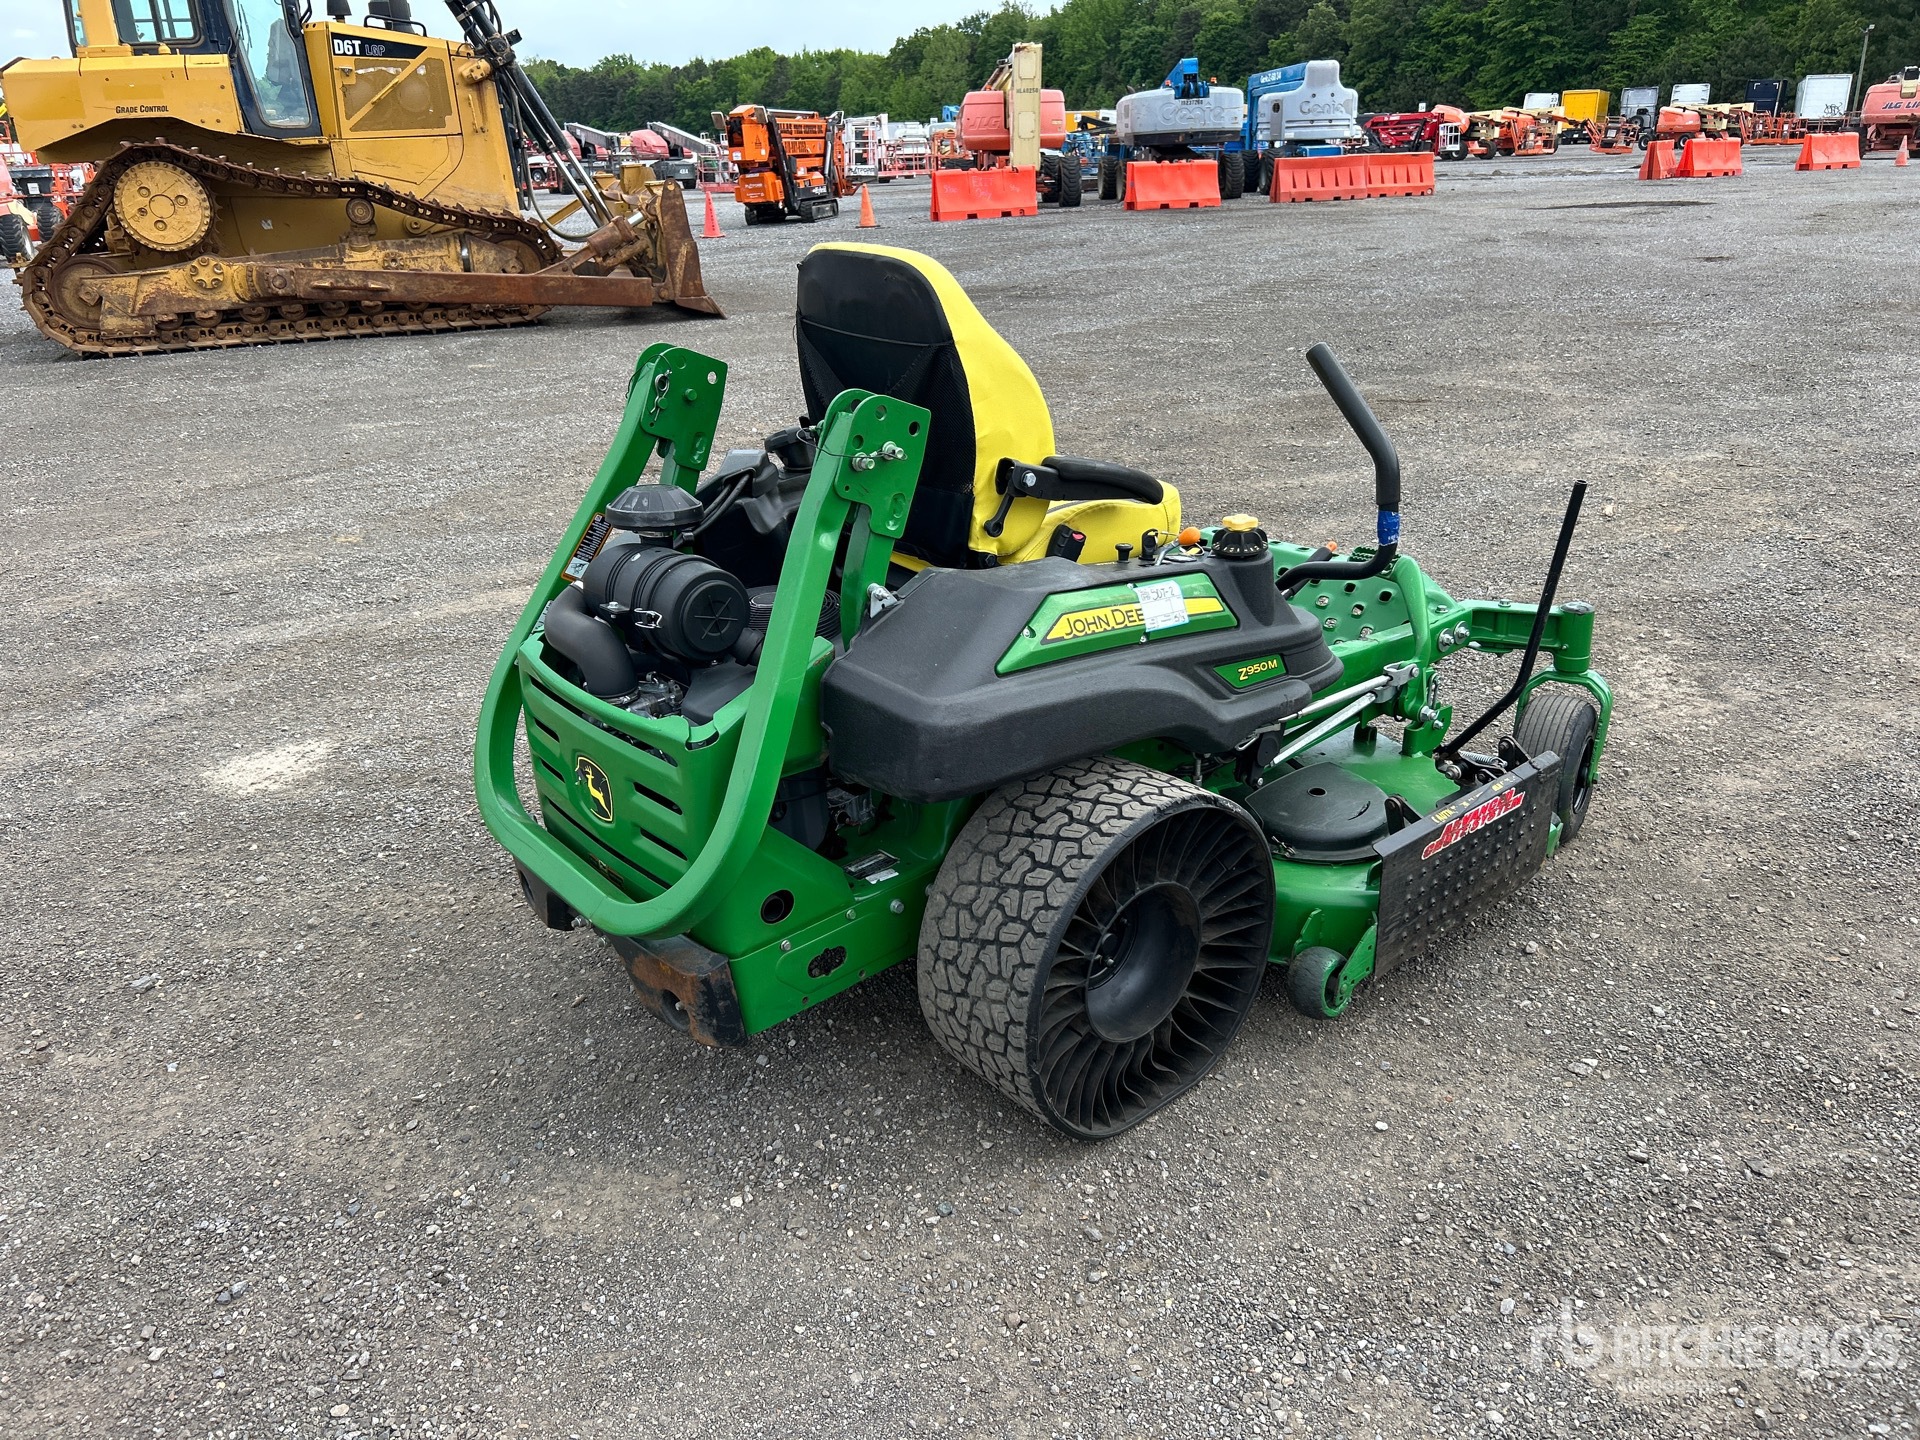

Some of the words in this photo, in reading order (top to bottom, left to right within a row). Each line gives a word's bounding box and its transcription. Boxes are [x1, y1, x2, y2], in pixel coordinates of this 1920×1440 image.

[333, 39, 361, 55] D6T
[115, 105, 138, 114] GRADE
[139, 104, 169, 114] CONTROL
[1300, 100, 1344, 115] Genie
[1881, 101, 1902, 110] JLG
[969, 116, 1001, 131] JLG
[1065, 613, 1111, 637] JOHN
[1111, 608, 1145, 626] DEE
[1237, 659, 1278, 681] Z950M
